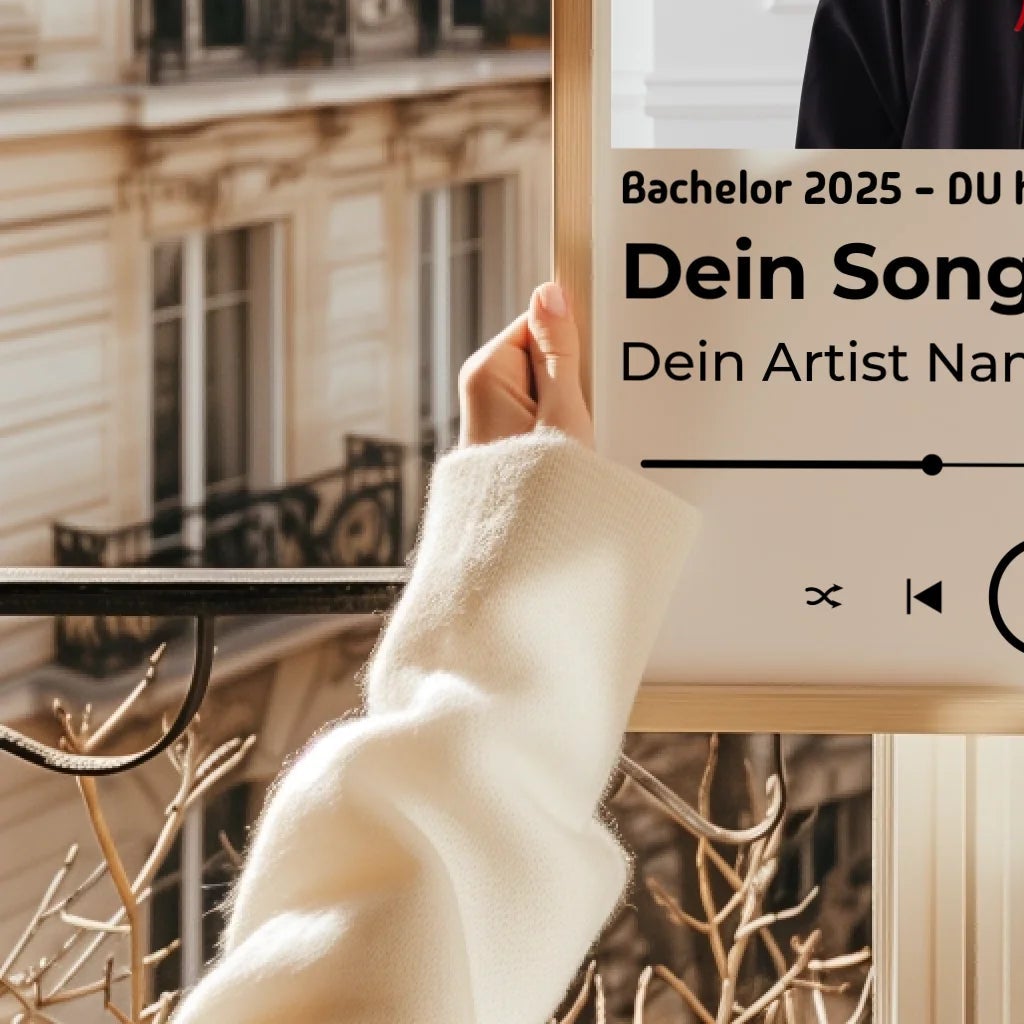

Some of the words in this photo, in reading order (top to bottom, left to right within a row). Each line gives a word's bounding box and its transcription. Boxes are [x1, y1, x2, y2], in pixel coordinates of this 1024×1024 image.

[622, 168, 793, 205] Bachelor
[804, 170, 902, 205] 2025
[948, 170, 1001, 205] DU
[625, 236, 806, 300] Dein
[622, 339, 743, 382] Dein
[761, 339, 909, 382] Artist
